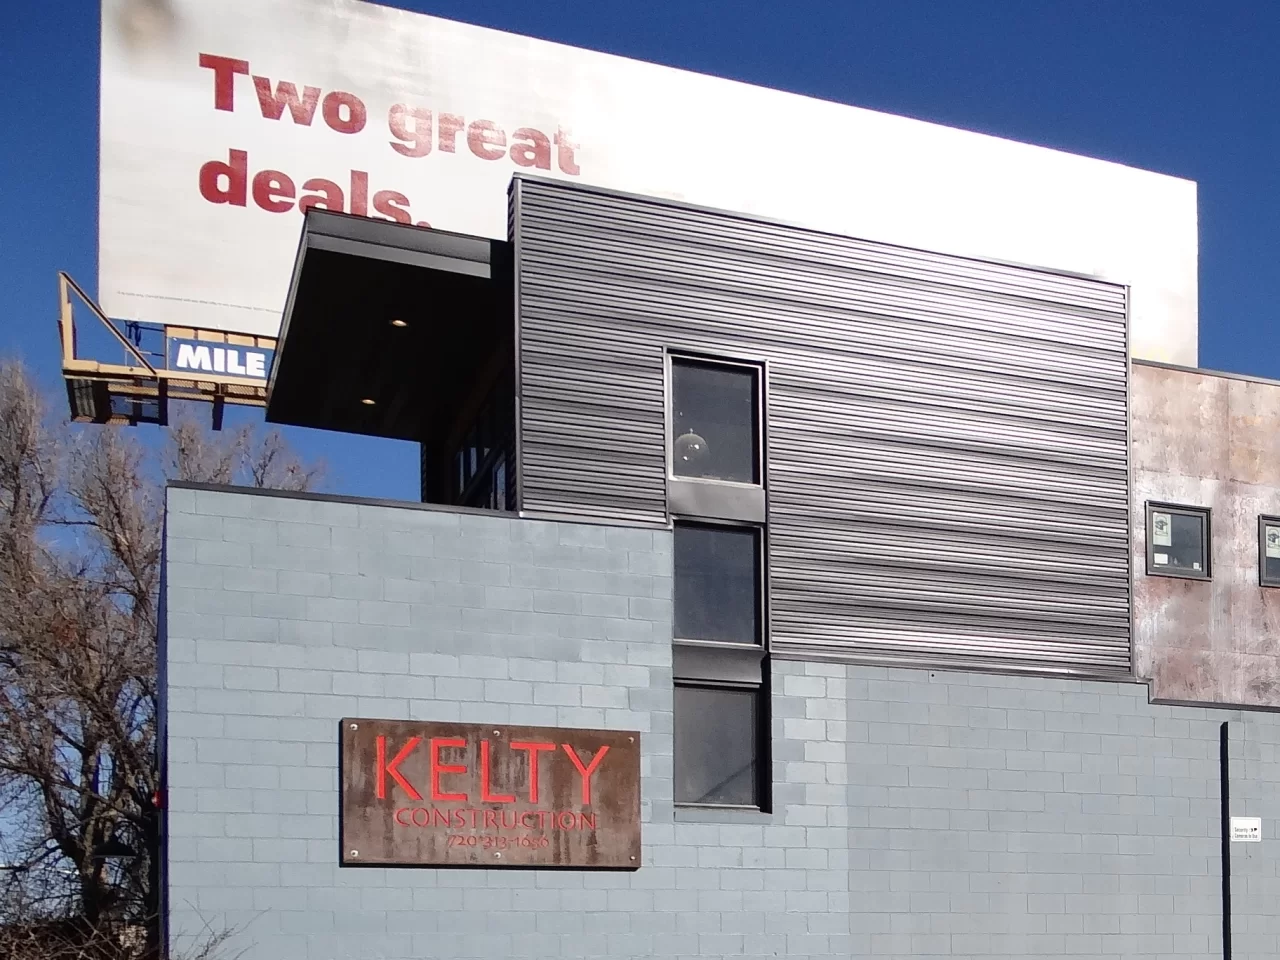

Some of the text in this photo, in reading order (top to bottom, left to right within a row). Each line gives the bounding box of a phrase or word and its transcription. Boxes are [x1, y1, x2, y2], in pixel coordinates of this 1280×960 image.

[199, 53, 581, 176] Two great
[176, 343, 266, 377] MILE
[376, 735, 610, 805] KELTY
[394, 807, 597, 830] CONSTRUCTION
